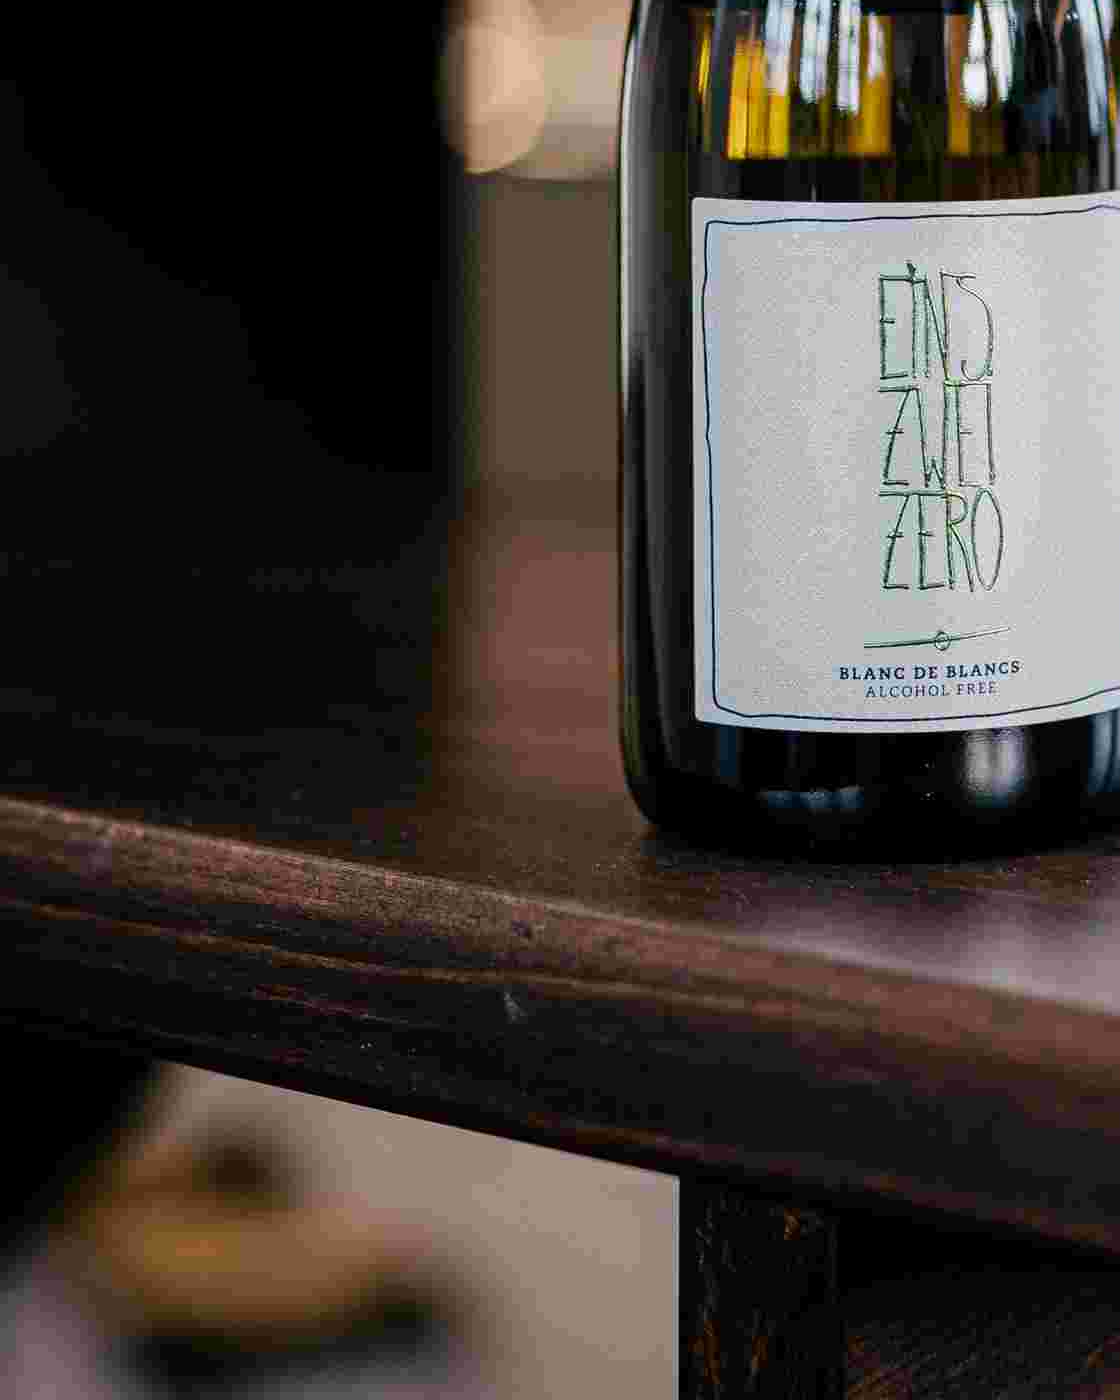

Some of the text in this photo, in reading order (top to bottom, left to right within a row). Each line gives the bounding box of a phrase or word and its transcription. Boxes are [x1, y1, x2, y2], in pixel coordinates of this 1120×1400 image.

[877, 379, 995, 489] ZWEI
[878, 487, 1004, 592] ZERO
[839, 660, 1020, 680] BLANC DE BLANCS
[865, 681, 996, 698] ALCOHOL FREE
